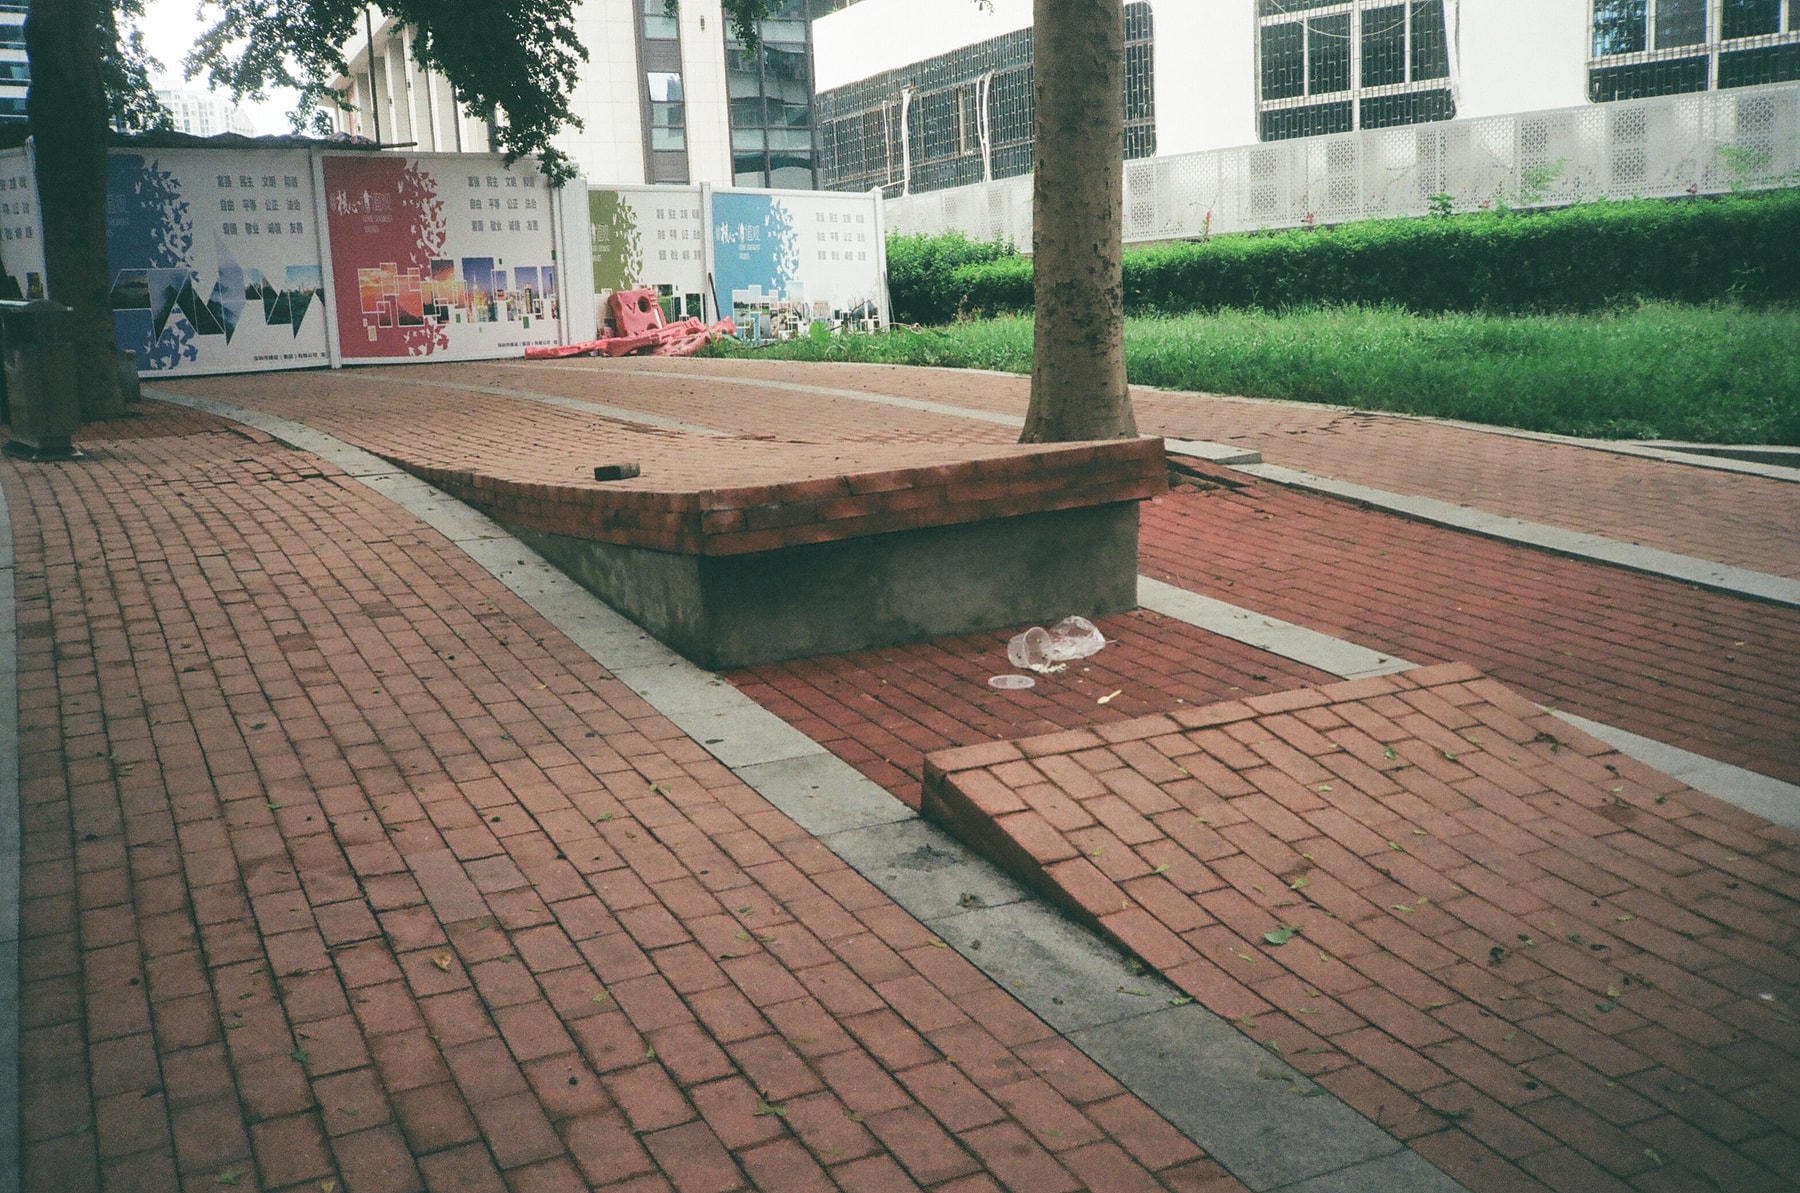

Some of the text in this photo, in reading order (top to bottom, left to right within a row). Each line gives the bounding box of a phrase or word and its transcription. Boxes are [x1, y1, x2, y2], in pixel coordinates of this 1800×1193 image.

[239, 175, 255, 188] 民主
[486, 176, 499, 187] 民主
[219, 198, 234, 211] 自由
[469, 198, 482, 210] 自由
